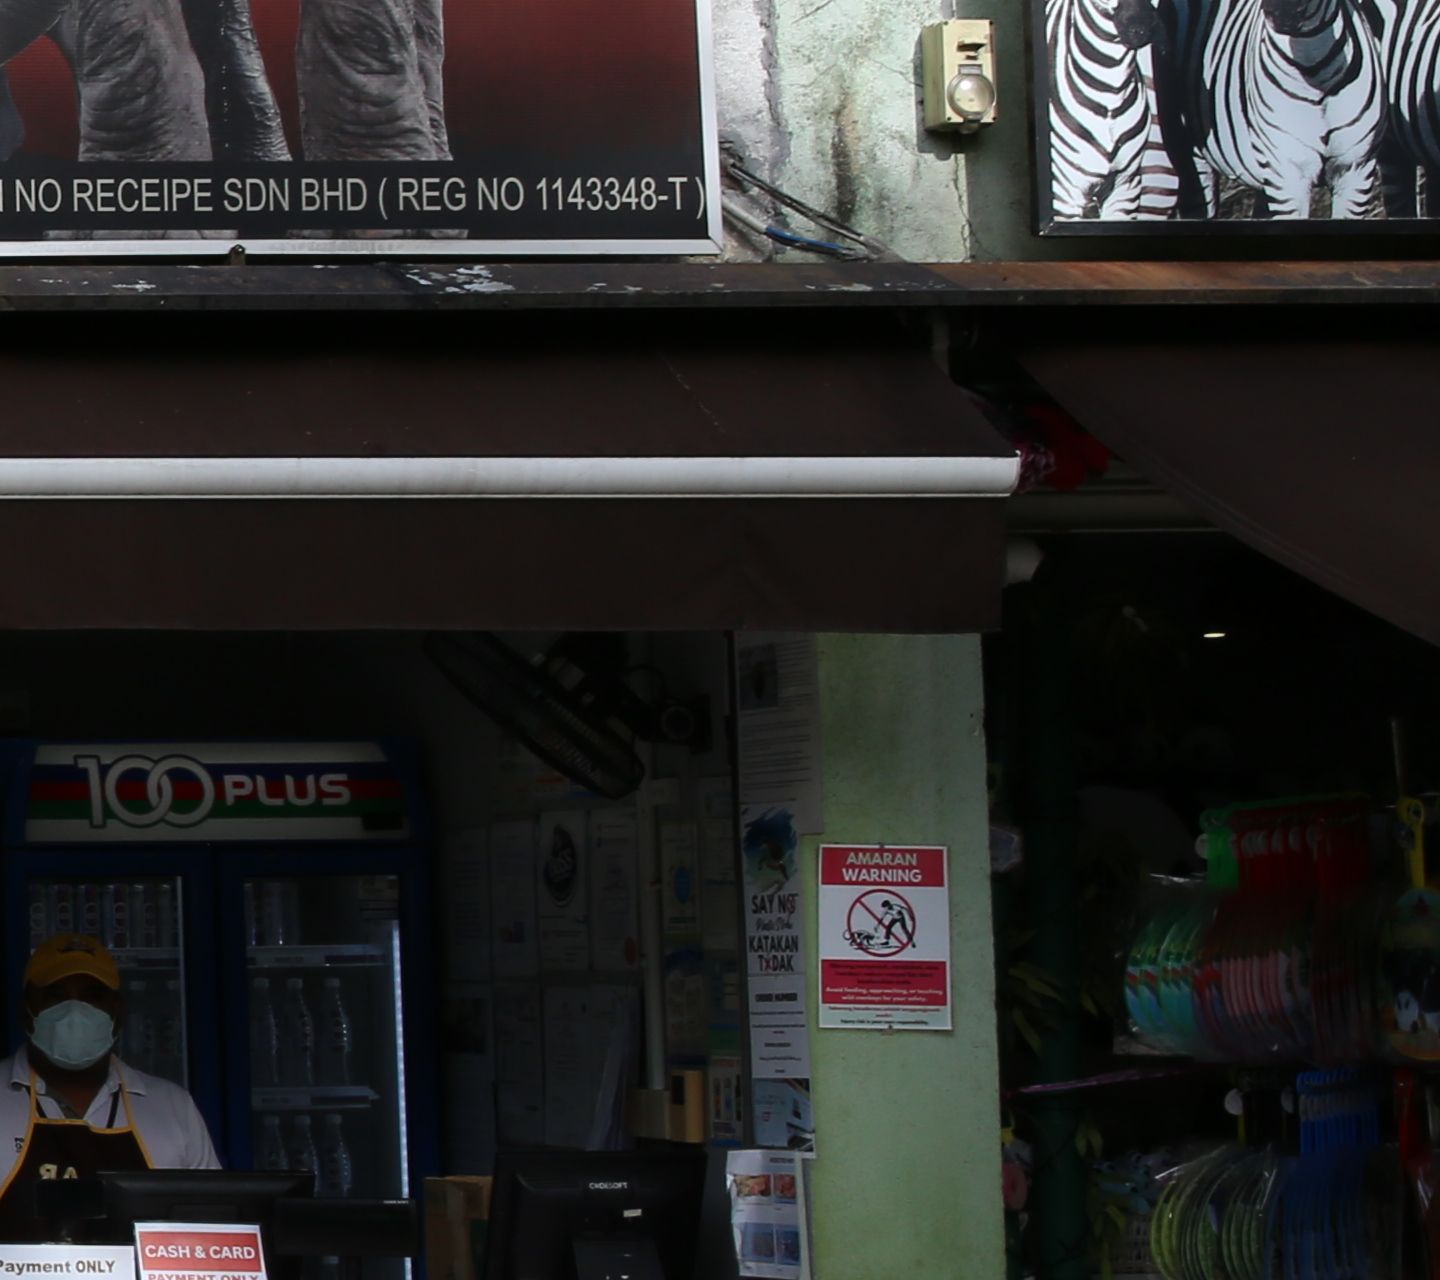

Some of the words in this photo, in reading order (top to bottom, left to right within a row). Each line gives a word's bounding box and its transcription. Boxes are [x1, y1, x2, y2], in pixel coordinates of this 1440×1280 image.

[13, 178, 63, 214] NO
[73, 178, 214, 213] RECEIPE
[222, 177, 292, 213] SDN
[300, 176, 368, 213] BHD
[397, 175, 467, 212] REG
[477, 175, 525, 212] NO
[534, 174, 686, 212] 1143348-T
[73, 753, 216, 828] 100
[223, 773, 353, 808] PLUS
[846, 852, 918, 866] AMARAN
[841, 867, 923, 883] WARNING
[751, 894, 775, 915] SAY
[749, 935, 799, 953] KATAKAN
[144, 1244, 191, 1260] CASH
[193, 1246, 207, 1259] &
[209, 1244, 256, 1261] CARD
[76, 1260, 116, 1273] ONLY
